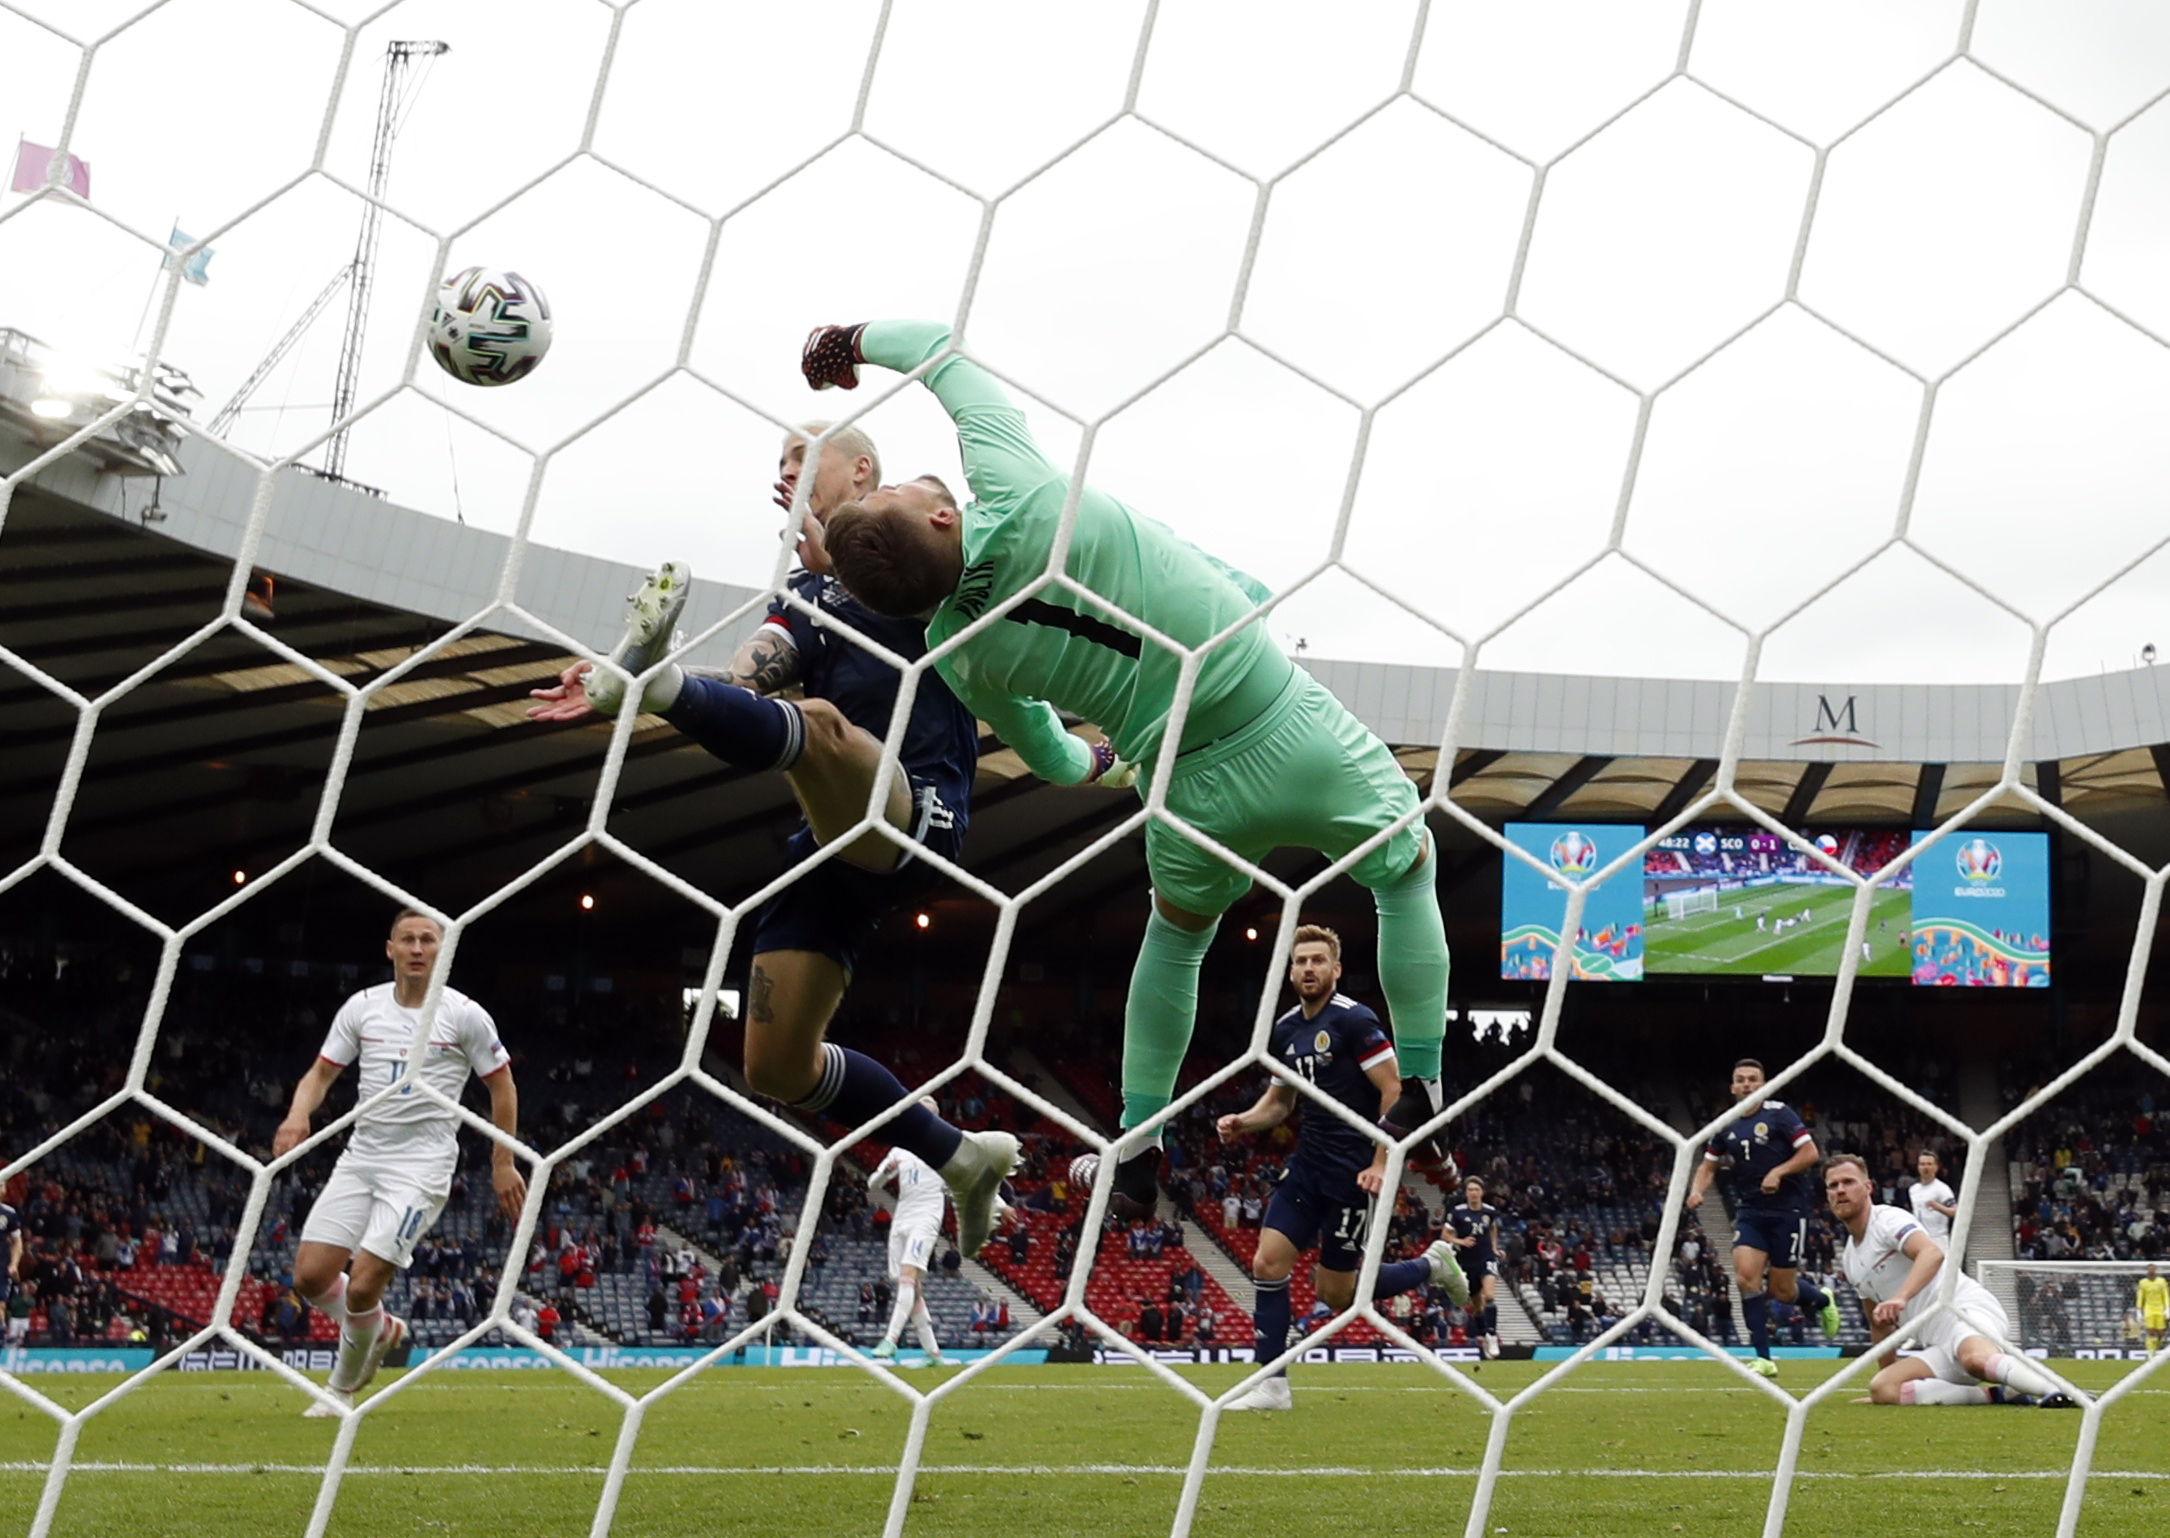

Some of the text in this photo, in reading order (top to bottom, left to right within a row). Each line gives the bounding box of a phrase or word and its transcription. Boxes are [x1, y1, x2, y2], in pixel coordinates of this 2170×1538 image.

[1005, 597, 1142, 661] 1
[1811, 694, 1860, 733] M
[1720, 837, 1744, 849] SCO
[1740, 1139, 1750, 1161] 7
[397, 1205, 423, 1240] 18
[1334, 1206, 1367, 1240] 17
[1790, 1233, 1799, 1254] 7
